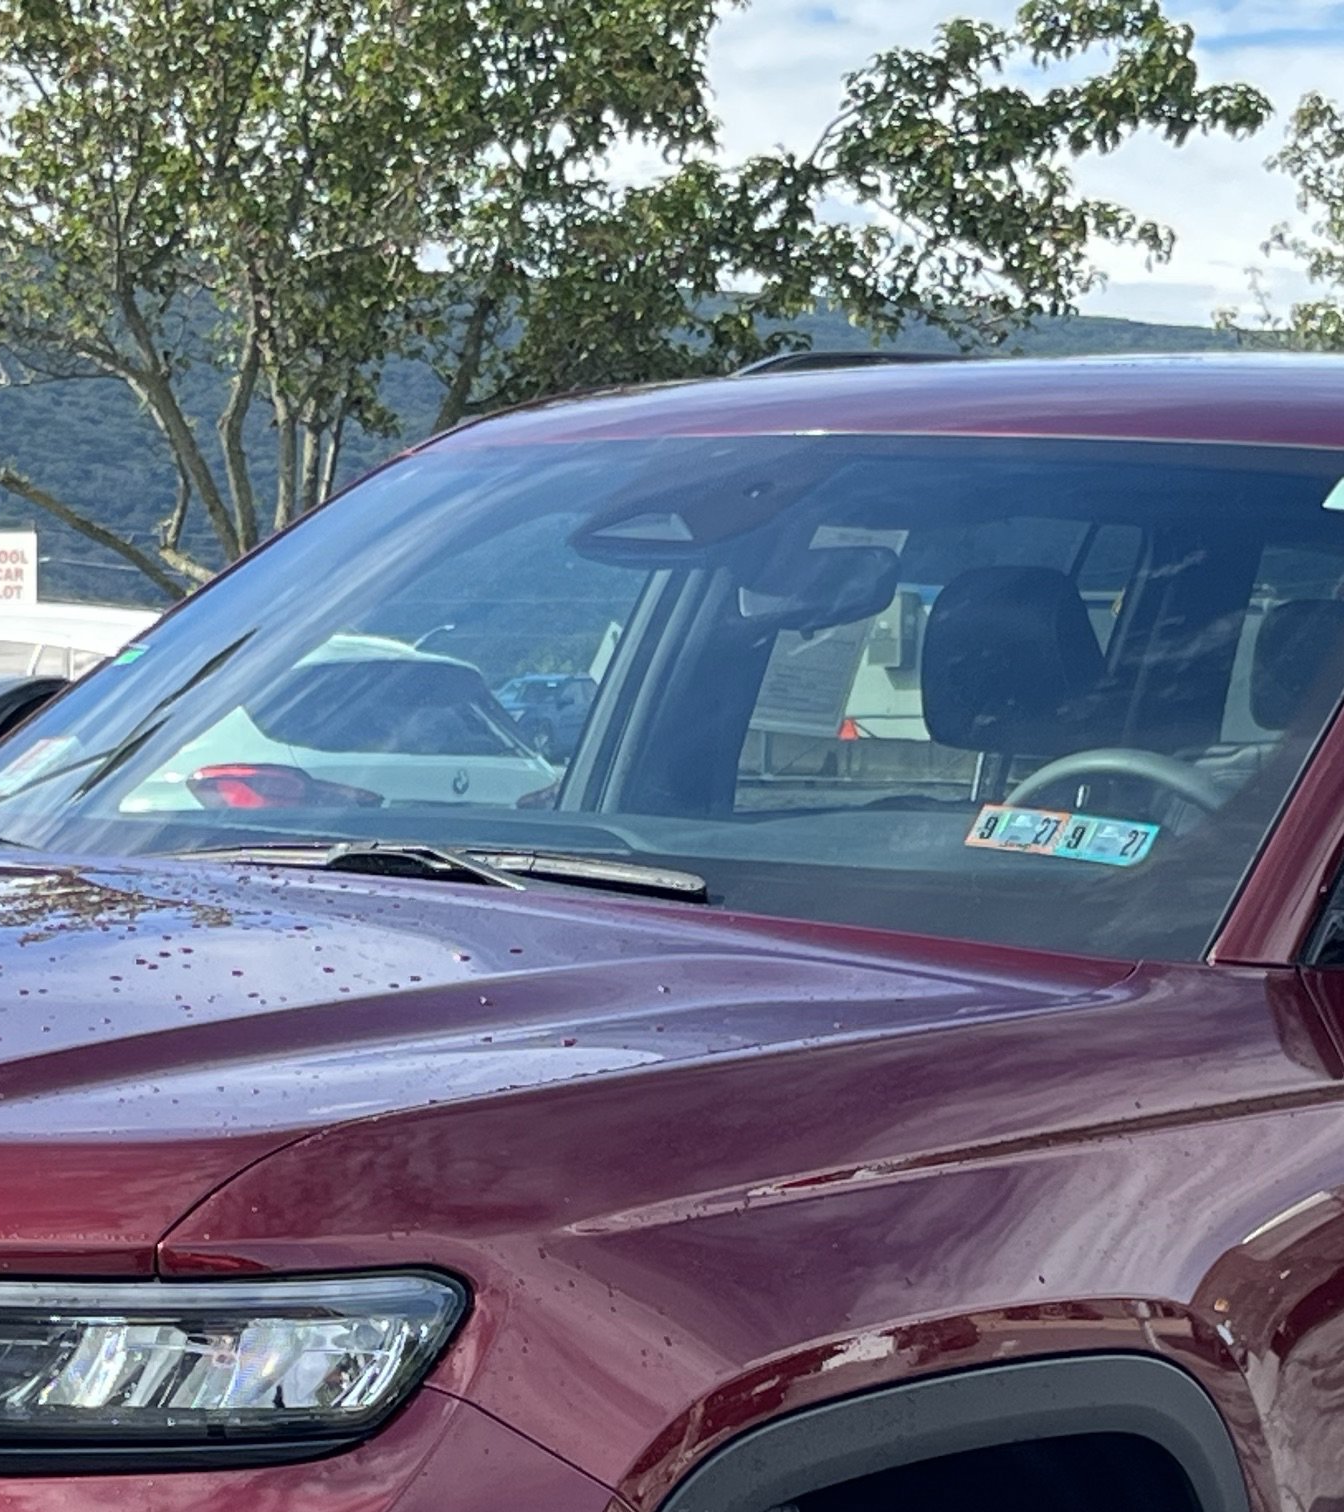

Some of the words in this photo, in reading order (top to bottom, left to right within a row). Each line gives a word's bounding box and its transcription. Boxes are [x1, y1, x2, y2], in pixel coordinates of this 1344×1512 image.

[979, 816, 999, 840] 9
[1032, 817, 1061, 846] 27
[1067, 825, 1087, 850] 9
[1119, 829, 1150, 858] 27
